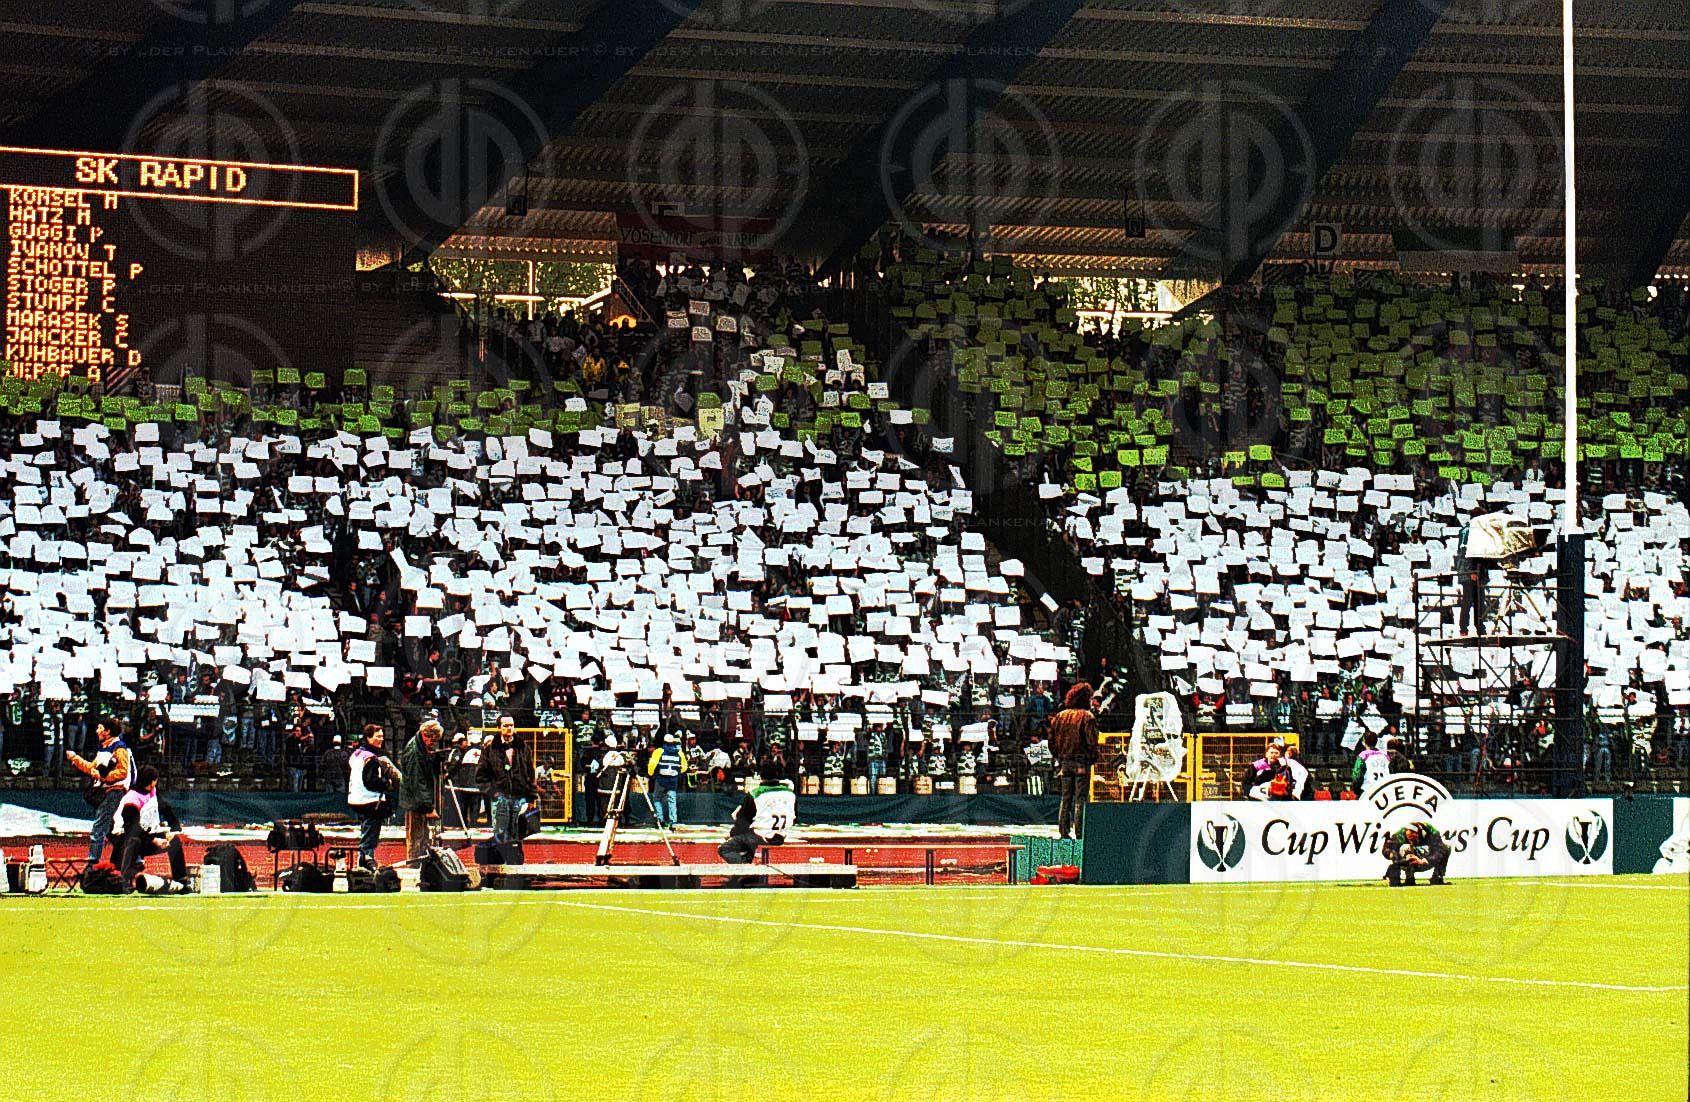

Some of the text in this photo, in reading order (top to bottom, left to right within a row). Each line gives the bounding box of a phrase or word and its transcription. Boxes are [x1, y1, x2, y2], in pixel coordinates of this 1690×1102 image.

[75, 157, 247, 192] SK RAPID
[9, 187, 91, 208] KONSEL
[9, 205, 63, 223] HATZ
[9, 222, 104, 243] GUGGI P
[1315, 225, 1338, 253] D
[10, 240, 117, 261] IVANOV T
[7, 257, 144, 280] SCHOTTEL P
[103, 280, 116, 295] P
[7, 292, 116, 313] STUMPF C
[6, 309, 129, 331] MARASEK S
[6, 326, 129, 348] JANCKER C
[128, 350, 142, 367] D
[1375, 785, 1439, 812] UEFA
[771, 814, 787, 831] 27
[1261, 819, 1329, 865] Cup
[1487, 816, 1550, 861] Cup
